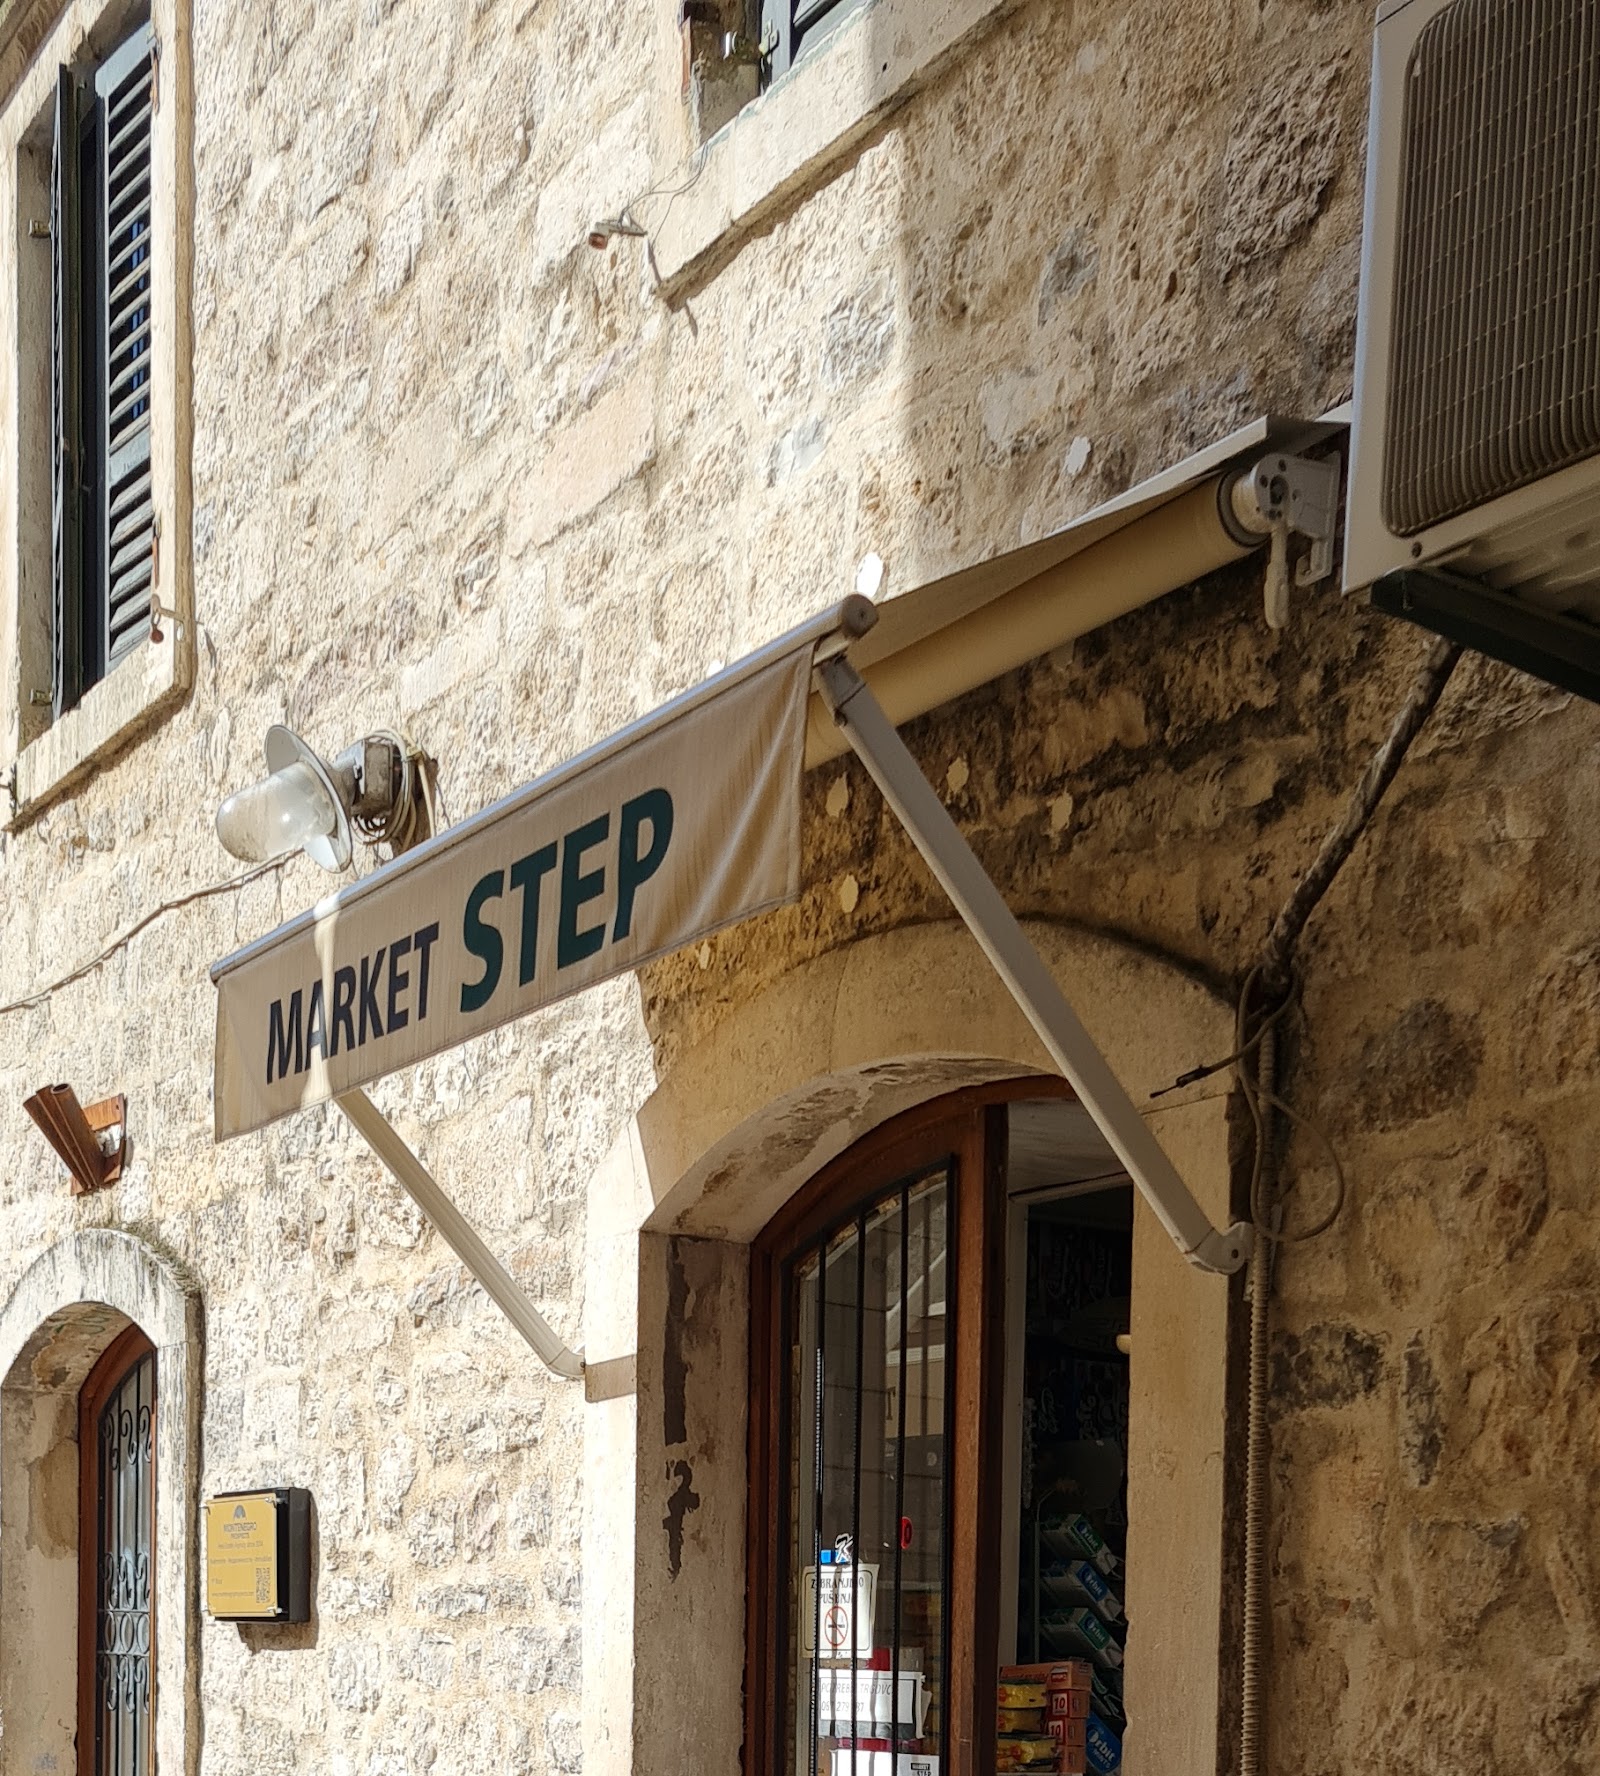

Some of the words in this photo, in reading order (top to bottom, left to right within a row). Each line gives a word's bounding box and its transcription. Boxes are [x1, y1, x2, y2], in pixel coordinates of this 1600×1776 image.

[266, 921, 440, 1085] MARKET
[459, 787, 674, 1014] STEP
[1081, 1567, 1104, 1594] Orbit
[1084, 1616, 1106, 1642] Orbit
[1054, 1697, 1066, 1710] 10
[1050, 1724, 1061, 1736] 10
[1087, 1728, 1115, 1762] Orbit
